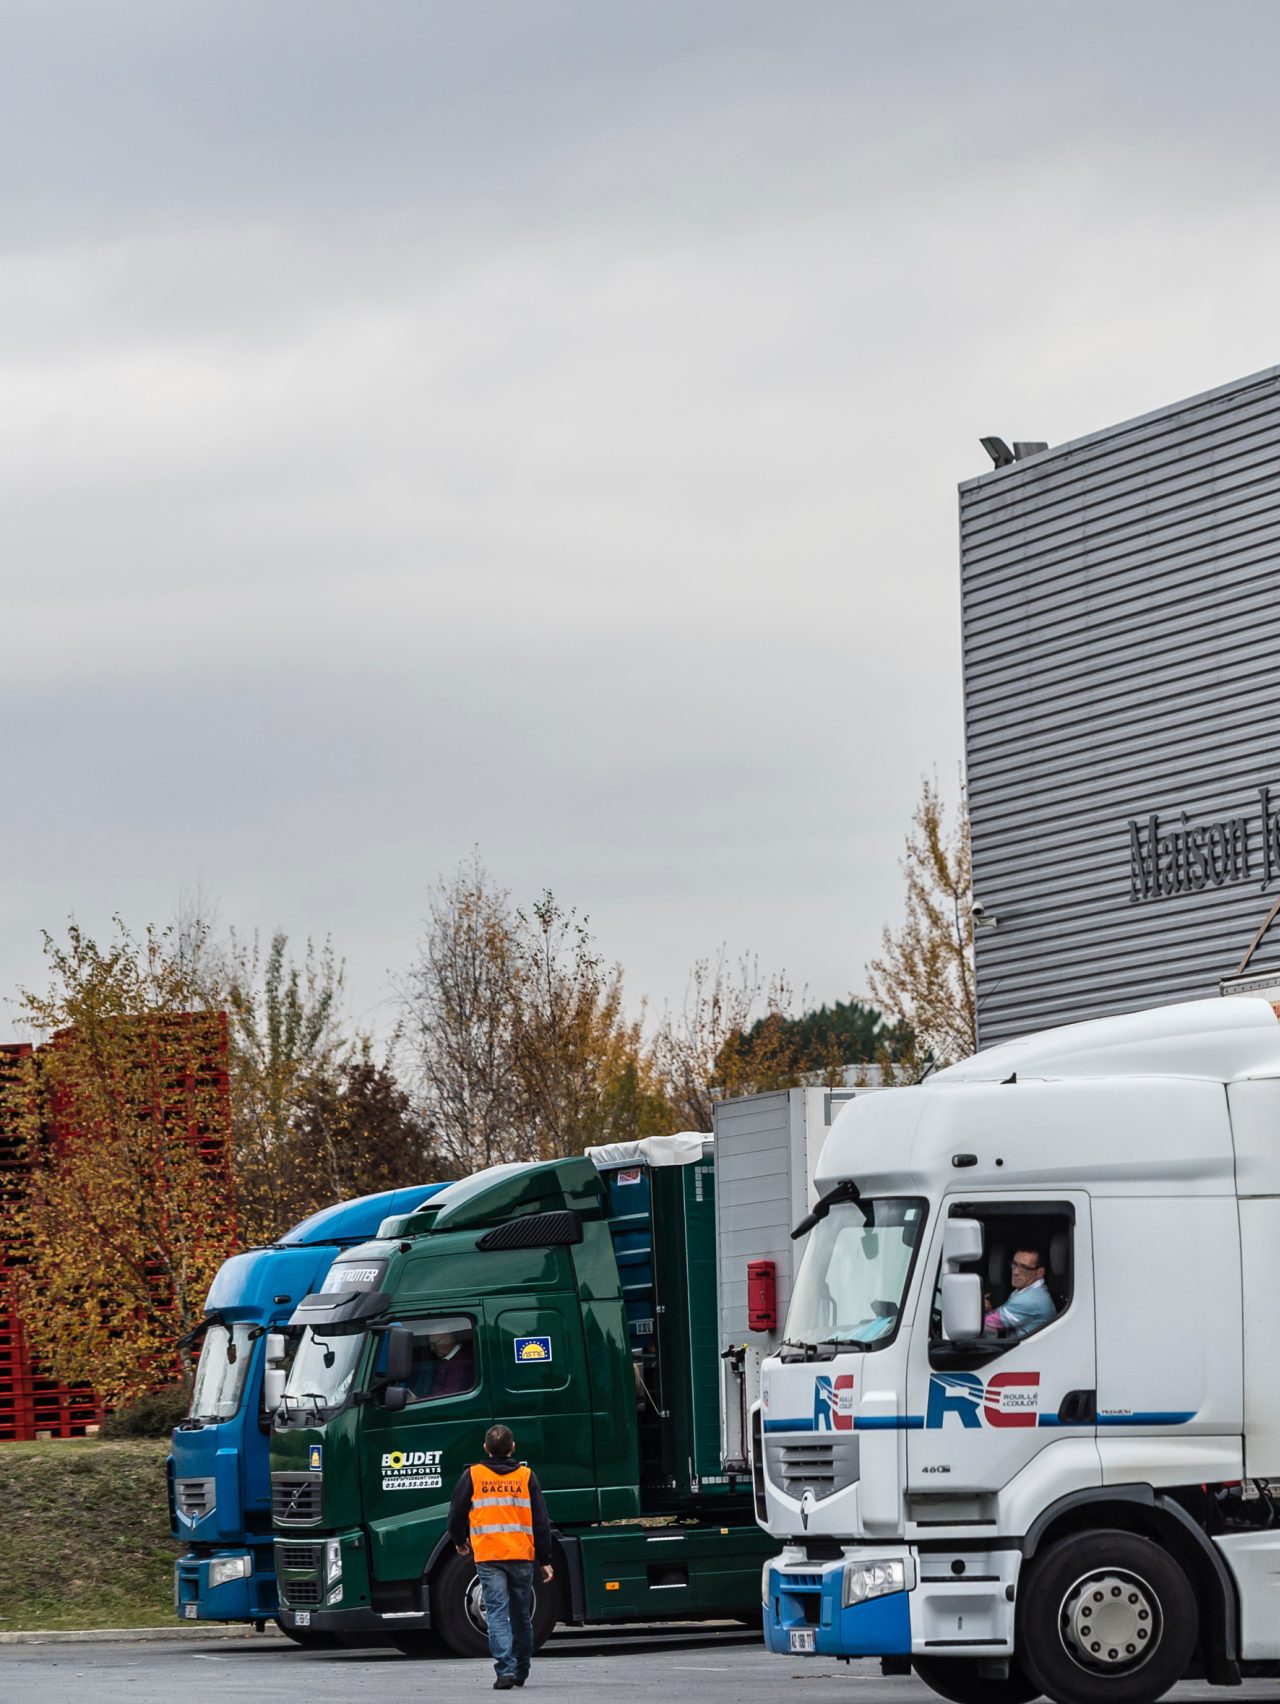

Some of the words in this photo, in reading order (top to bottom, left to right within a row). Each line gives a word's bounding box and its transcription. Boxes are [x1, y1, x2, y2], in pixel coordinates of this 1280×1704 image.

[1127, 811, 1250, 902] Maison
[381, 1450, 443, 1469] BOUDET
[381, 1467, 442, 1476] TRANSPORTS
